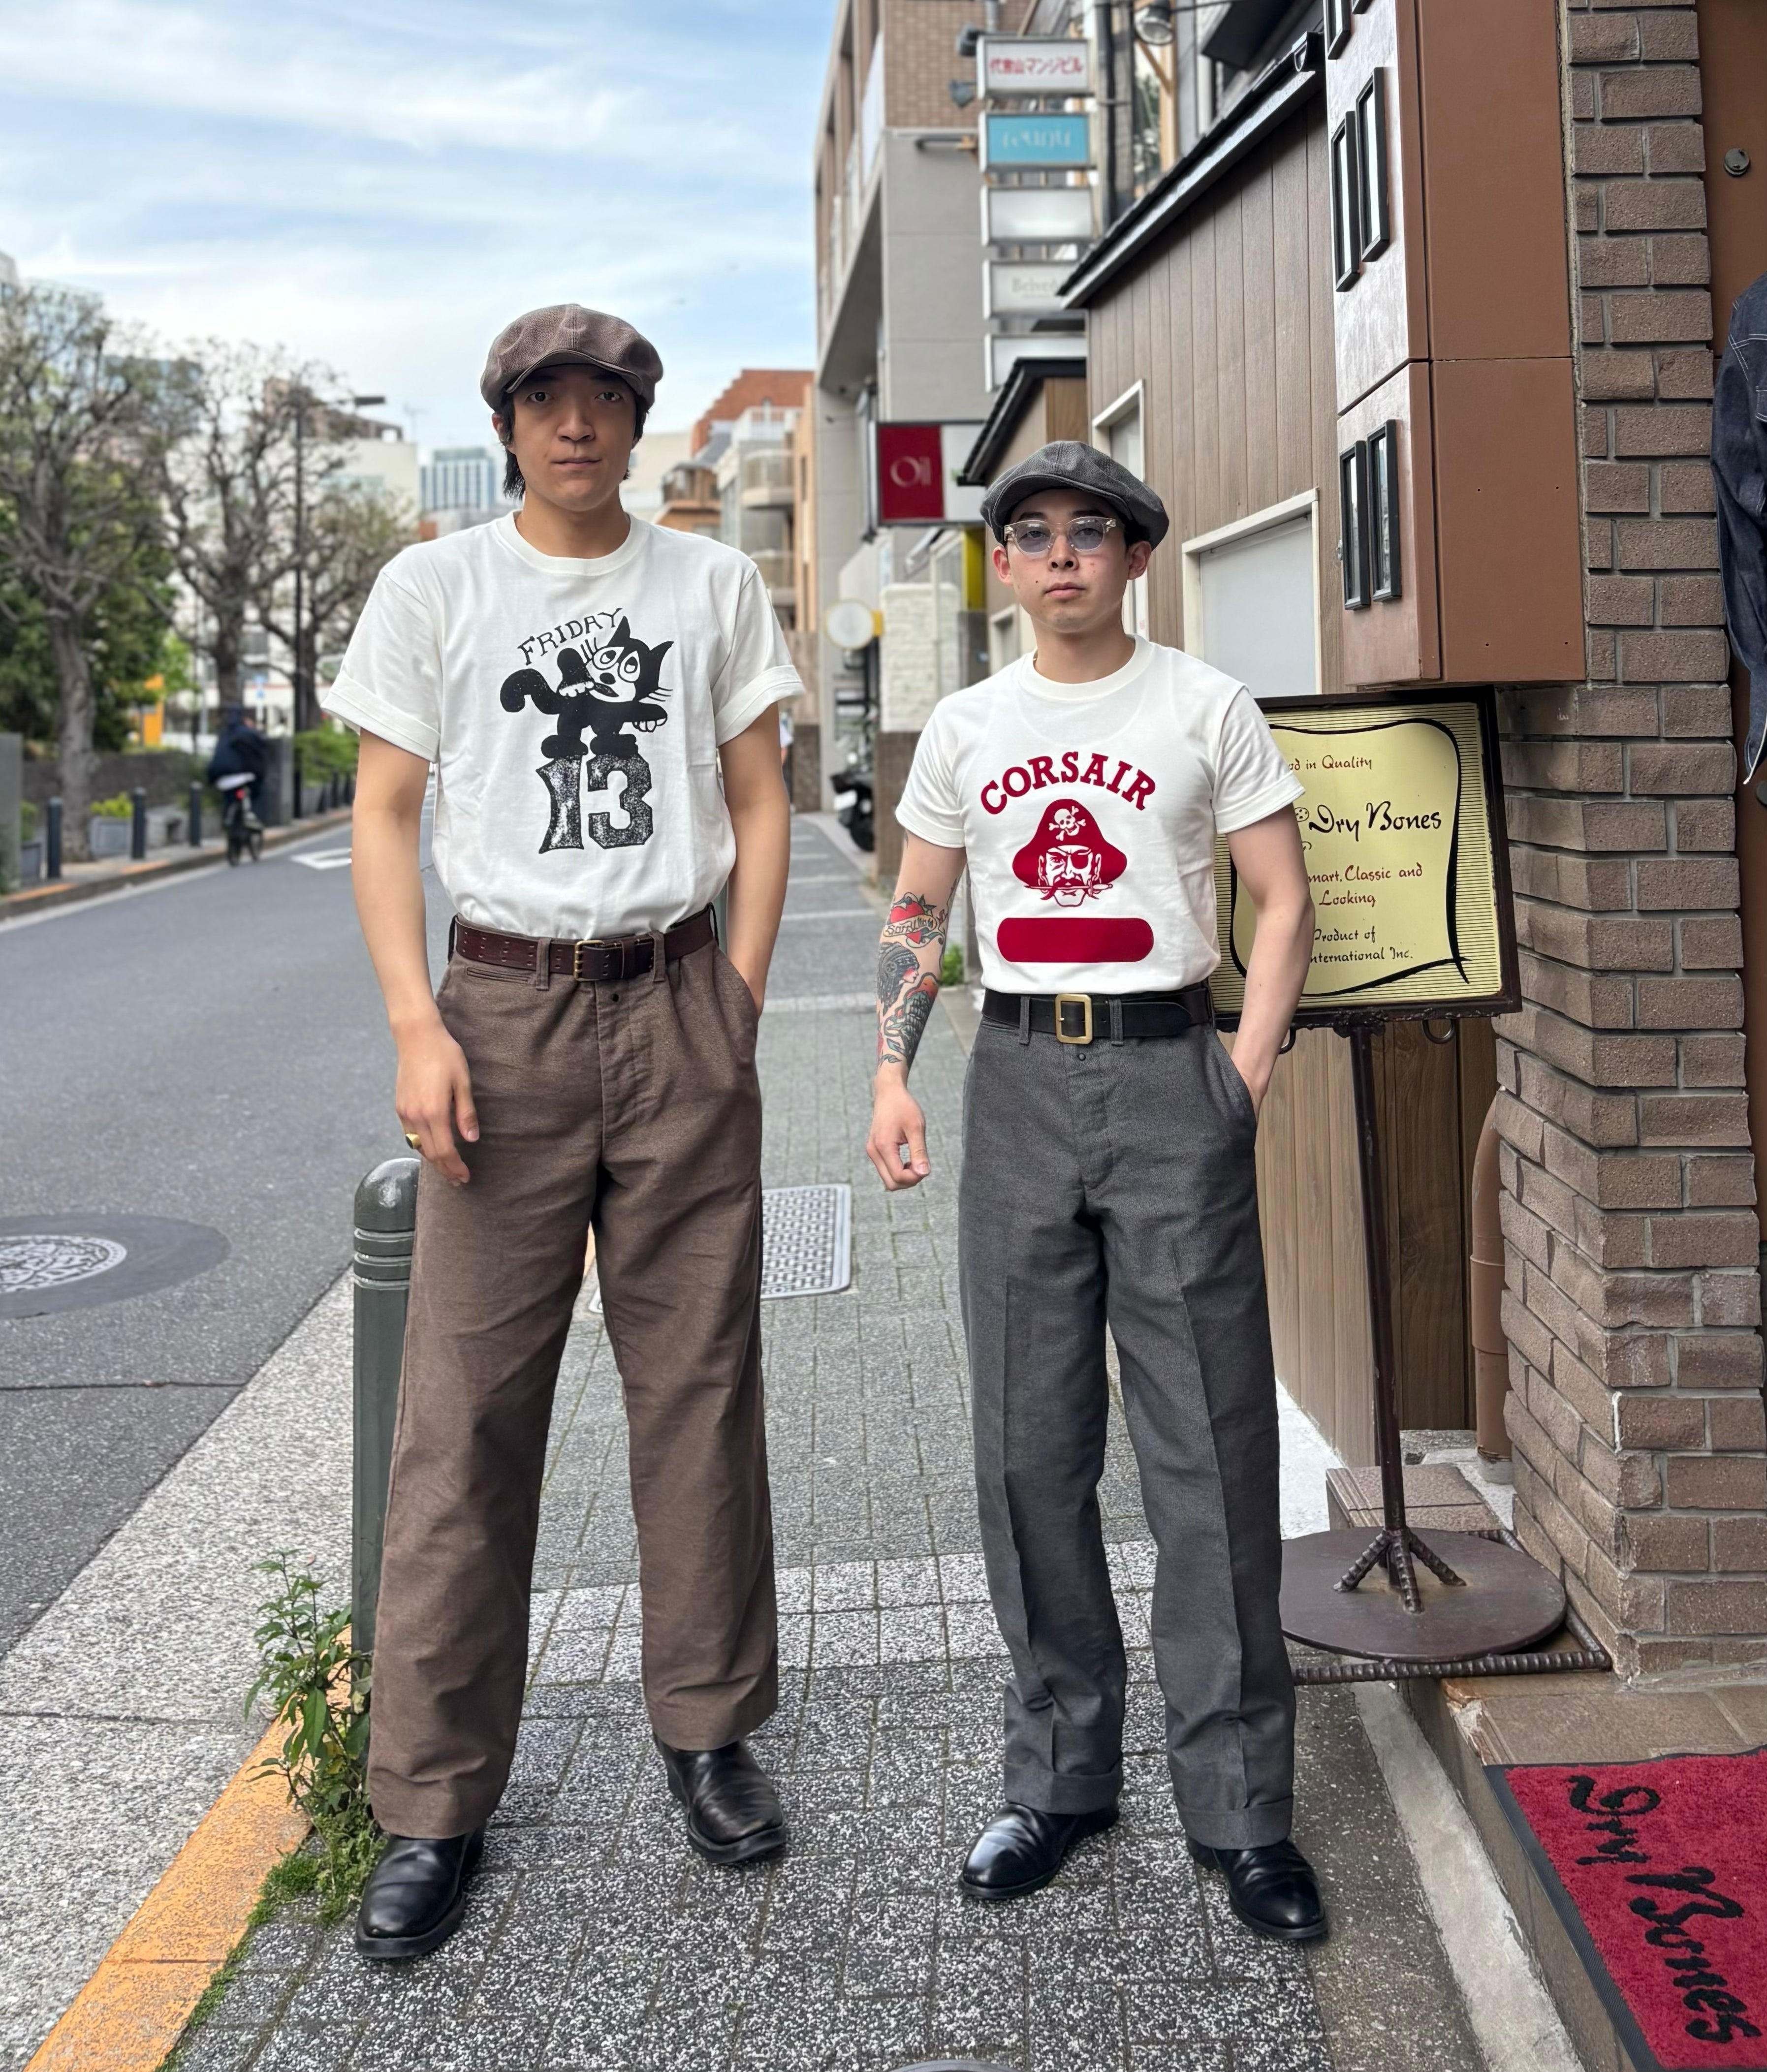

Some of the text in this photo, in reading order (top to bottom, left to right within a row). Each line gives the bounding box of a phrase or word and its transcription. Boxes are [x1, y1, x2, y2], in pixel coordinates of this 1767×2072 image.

[517, 607, 623, 666] FRIDAY
[1288, 754, 1372, 771] od in Quality
[980, 751, 1156, 815] CORSAIR
[536, 753, 654, 854] 13
[1308, 801, 1442, 842] Dry Bones
[1307, 861, 1423, 883] mart. Classic and
[1318, 889, 1376, 908] Looking
[1363, 925, 1376, 943] of
[1310, 946, 1414, 964] nternational Inc.
[1625, 1867, 1763, 2043] Bones
